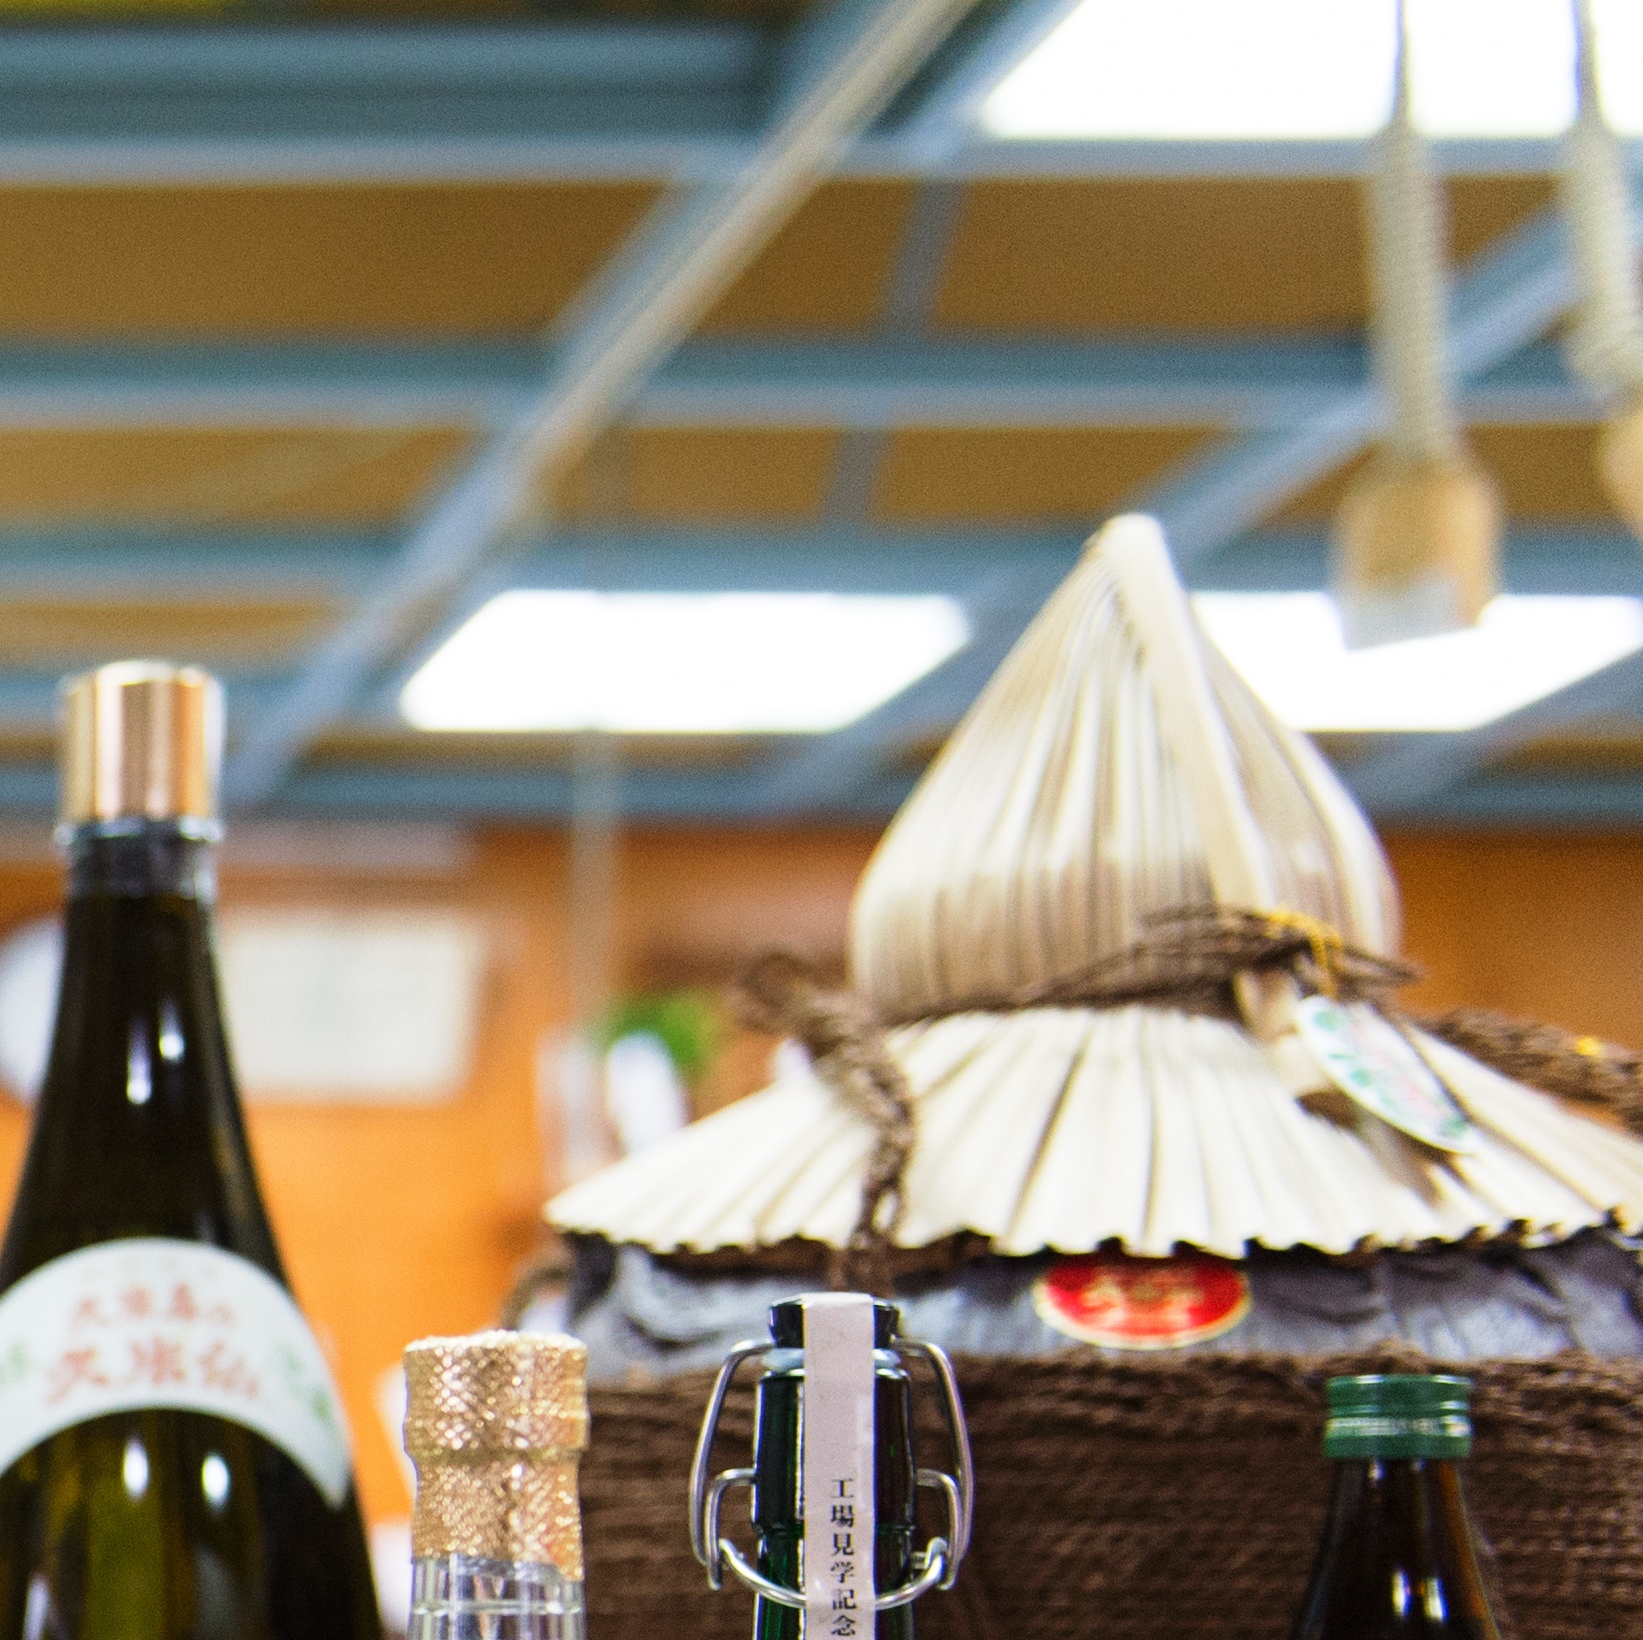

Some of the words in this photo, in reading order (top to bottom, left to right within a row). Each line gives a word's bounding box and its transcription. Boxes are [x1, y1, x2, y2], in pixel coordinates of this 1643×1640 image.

[830, 1477, 857, 1638] 工場見学記念
